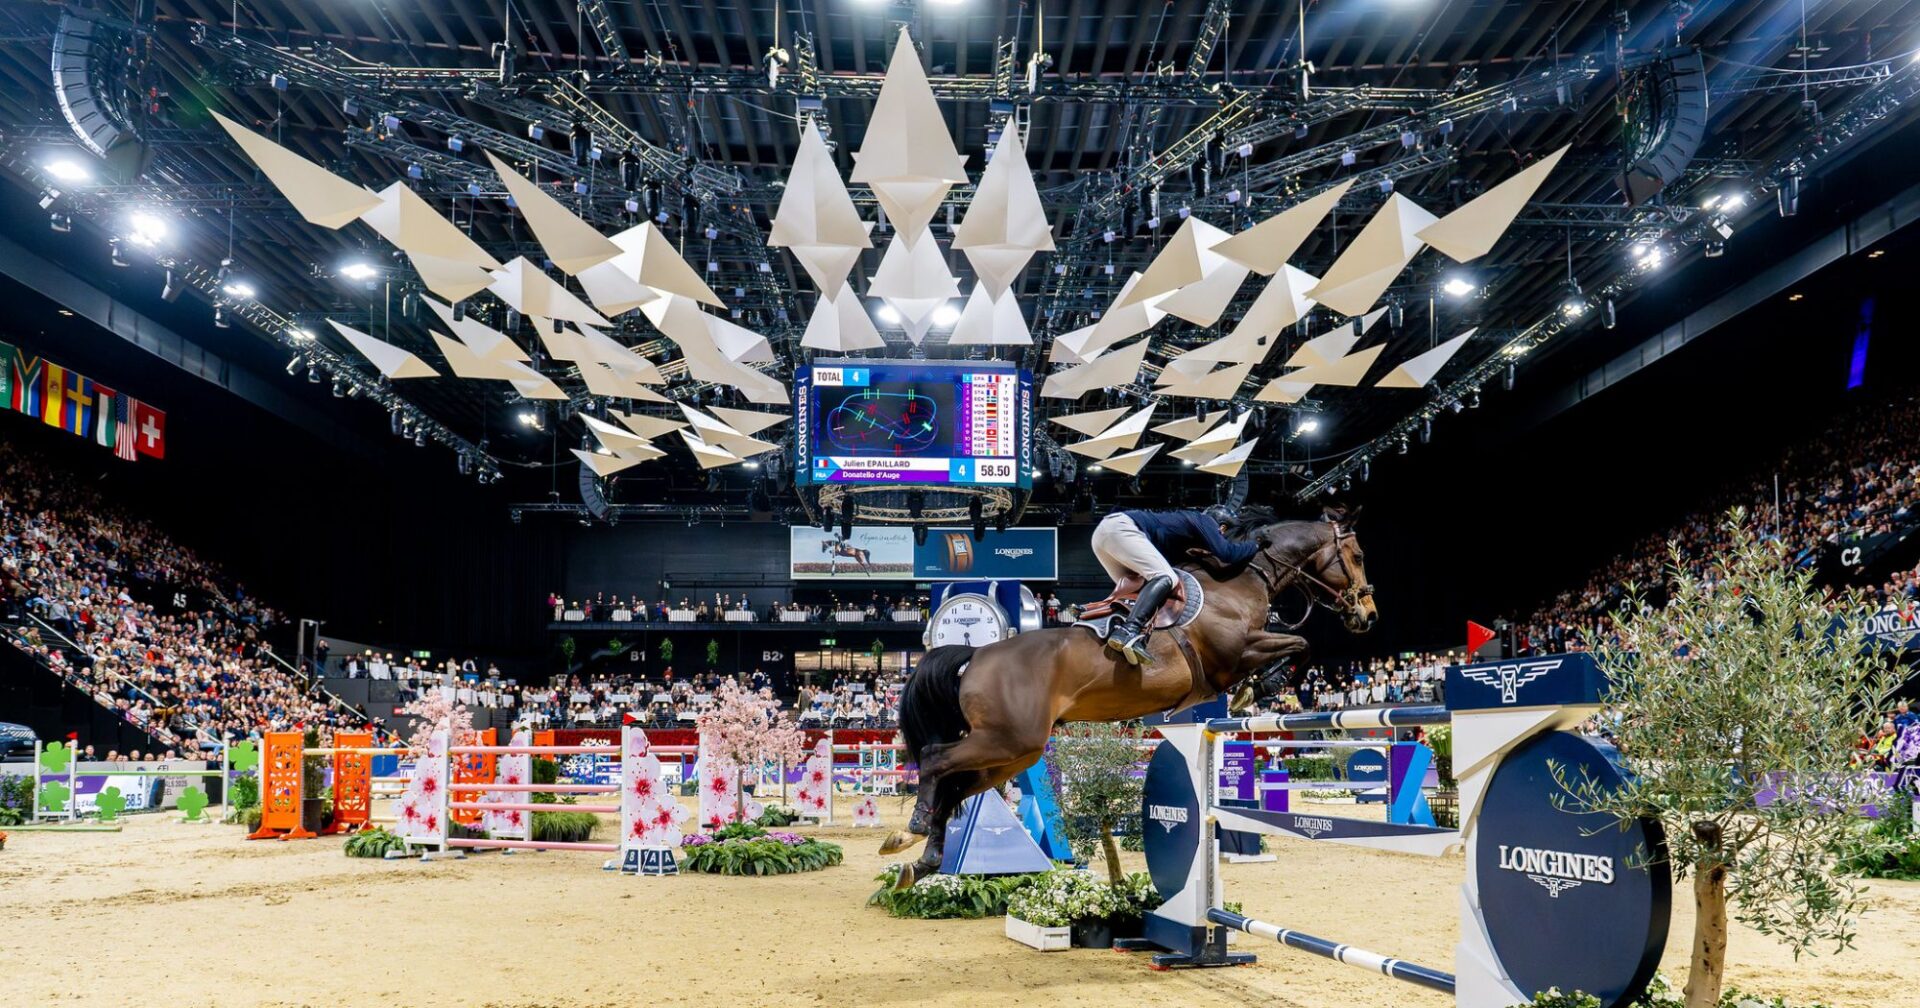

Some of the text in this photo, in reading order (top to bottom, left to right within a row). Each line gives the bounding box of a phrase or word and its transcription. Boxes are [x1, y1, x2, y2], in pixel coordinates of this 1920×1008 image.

[817, 372, 841, 382] TOTAL
[852, 371, 859, 382] 4
[798, 385, 807, 466] LONGINES
[1022, 390, 1030, 469] LONGINES
[877, 472, 900, 480] d'Auge
[959, 464, 1010, 477] 4 58.50
[1841, 548, 1861, 566] C2
[173, 593, 187, 608] A5
[1855, 608, 1920, 634] ONGN
[630, 651, 646, 661] B1
[763, 651, 779, 661] B2
[126, 794, 142, 807] 58.5
[1150, 805, 1188, 822] LONGINES
[1294, 816, 1332, 832] LONGINES
[630, 851, 635, 861] 8
[650, 852, 657, 863] A
[665, 852, 671, 862] A
[1499, 845, 1614, 884] LONGINES
